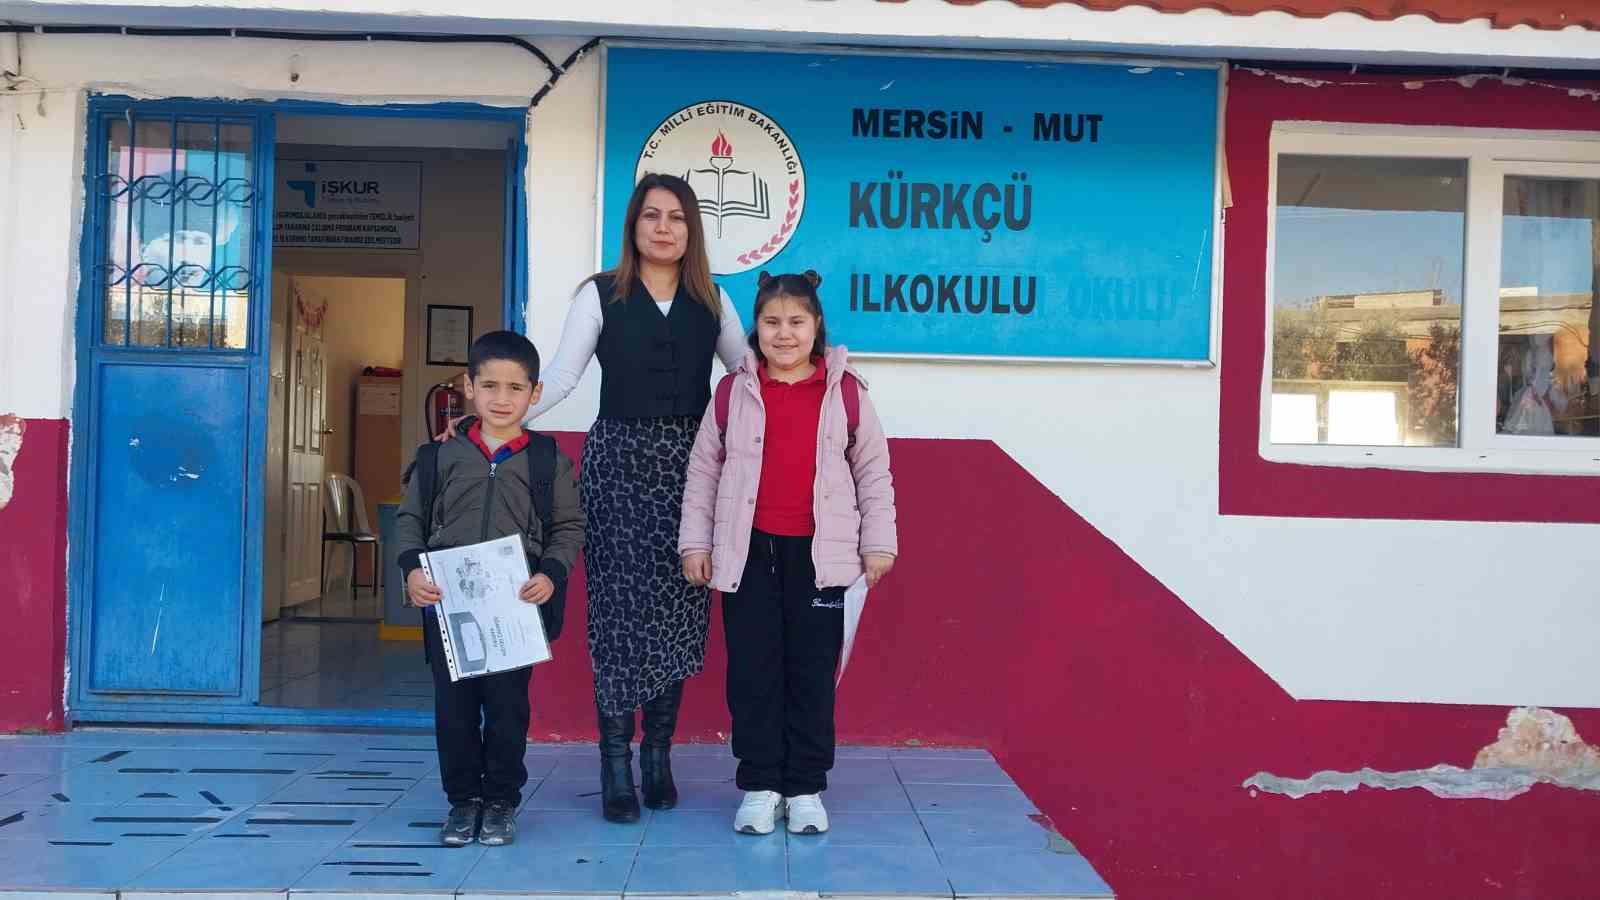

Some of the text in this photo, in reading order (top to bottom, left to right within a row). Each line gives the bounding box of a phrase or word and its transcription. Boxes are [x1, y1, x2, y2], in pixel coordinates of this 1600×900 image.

[643, 138, 662, 159] T.C.
[697, 103, 745, 118] EĞİTİM
[748, 112, 799, 175] BAKANLIĞI
[1003, 125, 1013, 133] -
[1033, 112, 1104, 143] MUT
[849, 169, 1032, 243] KÜRKÇÜ
